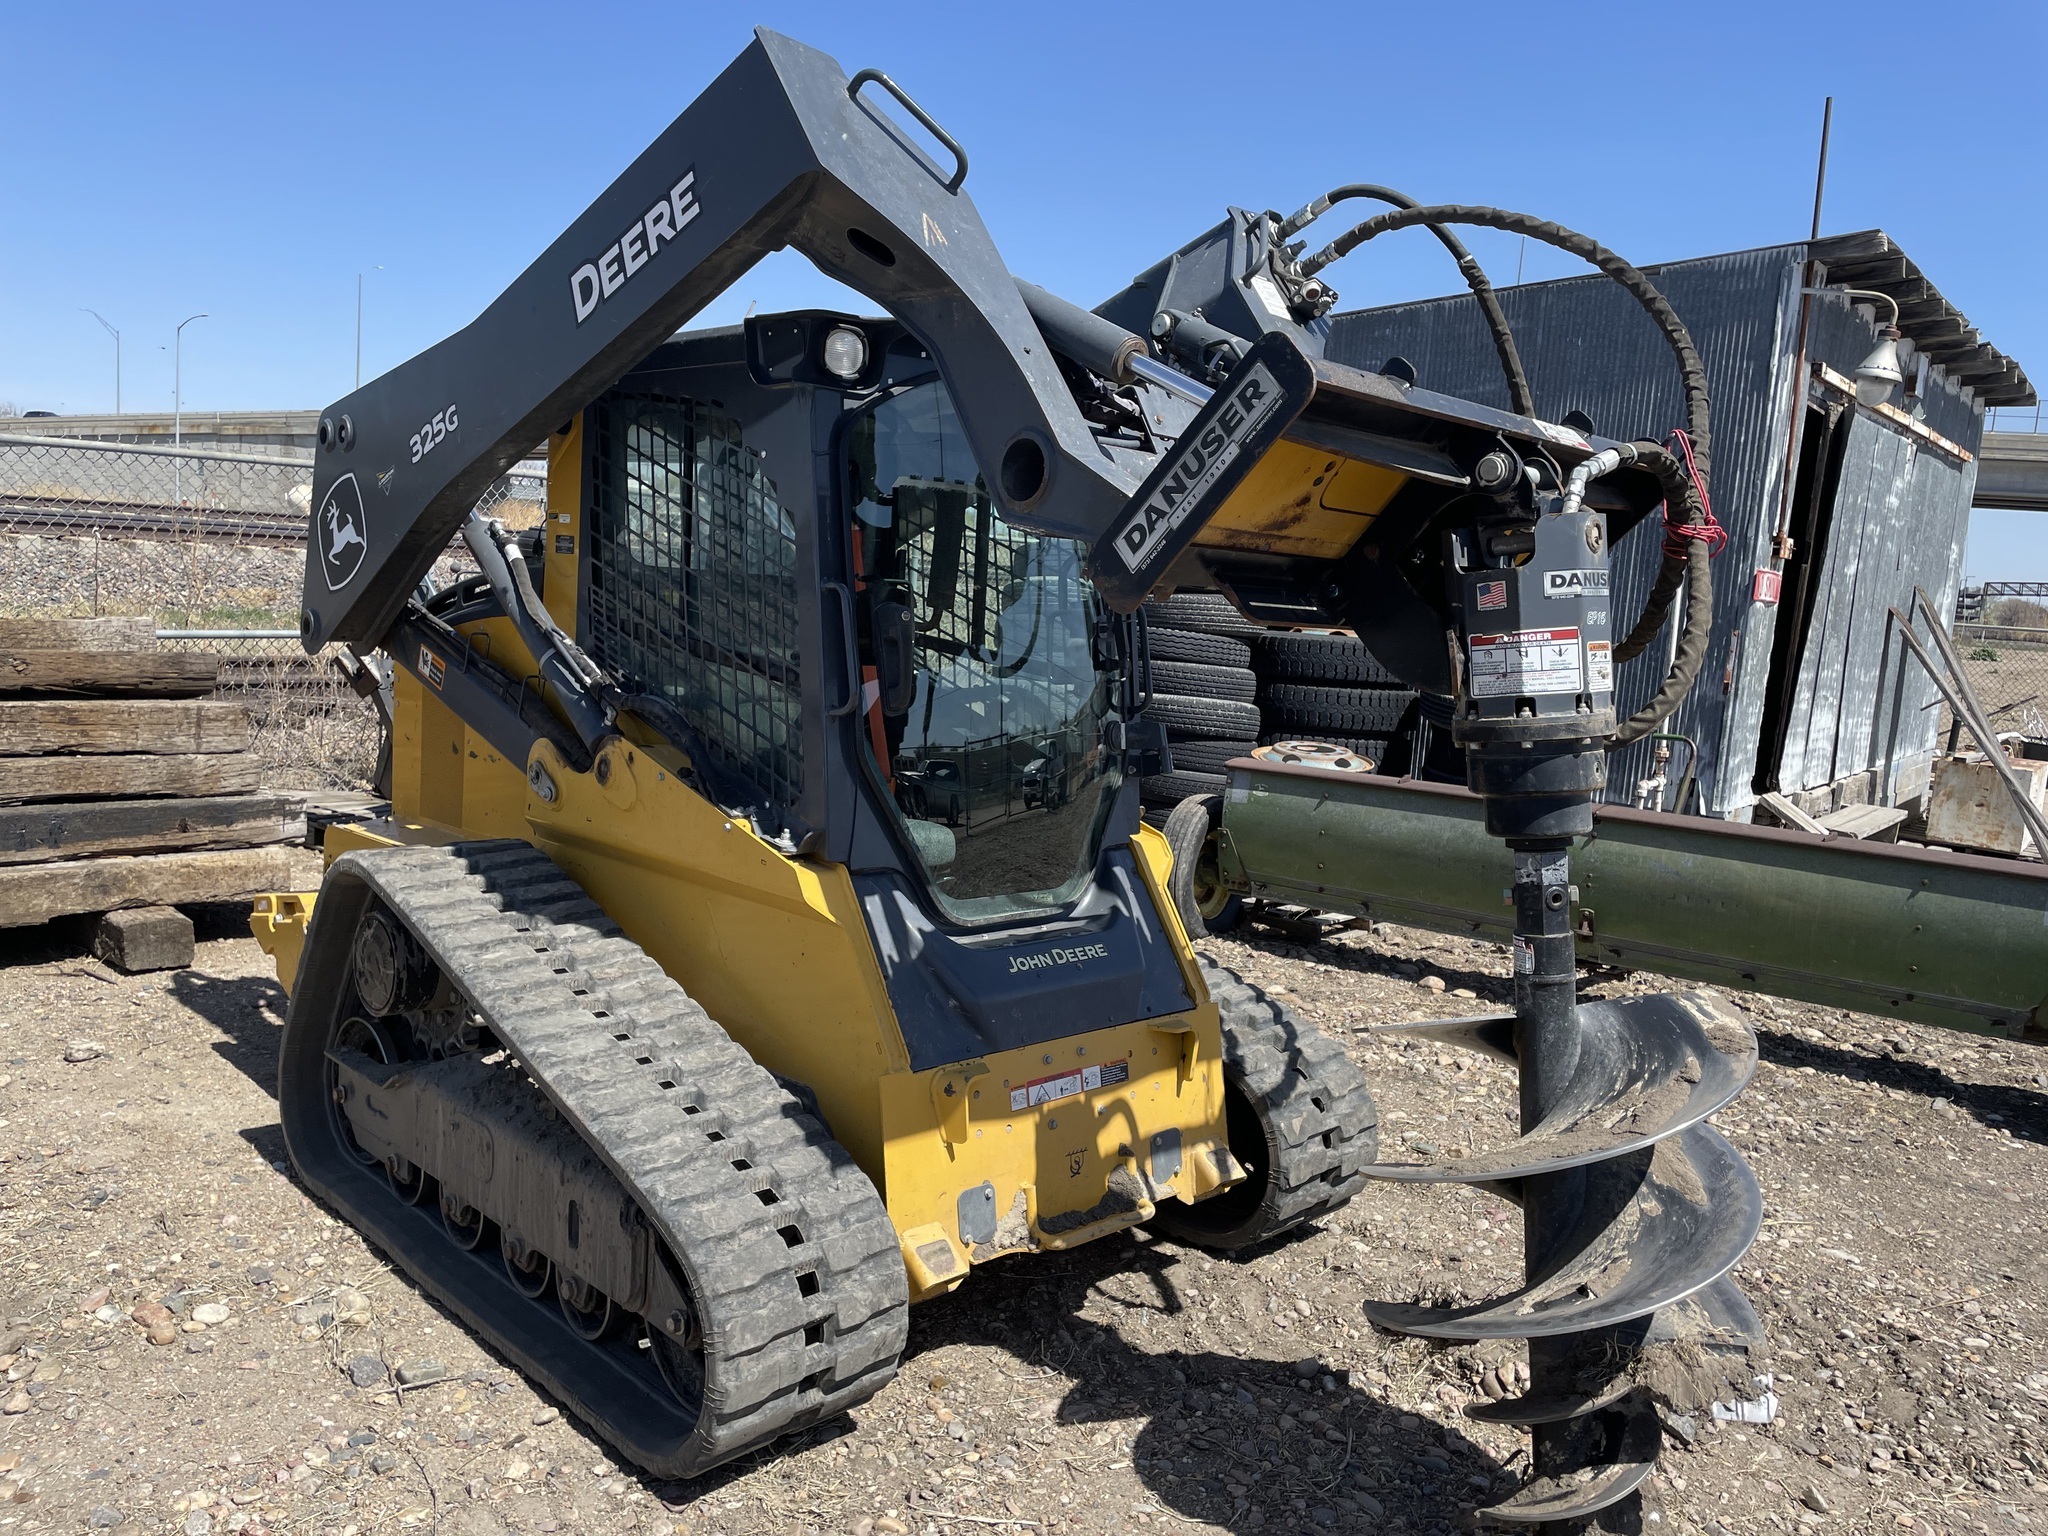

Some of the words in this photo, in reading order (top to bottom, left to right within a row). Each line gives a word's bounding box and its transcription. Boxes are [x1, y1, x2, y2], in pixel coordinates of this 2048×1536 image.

[571, 171, 700, 323] DEERE
[409, 404, 459, 464] 325G
[1122, 378, 1268, 556] DANUSER
[1182, 493, 1201, 513] EST.
[1205, 459, 1226, 484] 1910
[1009, 953, 1054, 973] JOHN
[1051, 943, 1108, 965] DEERE
